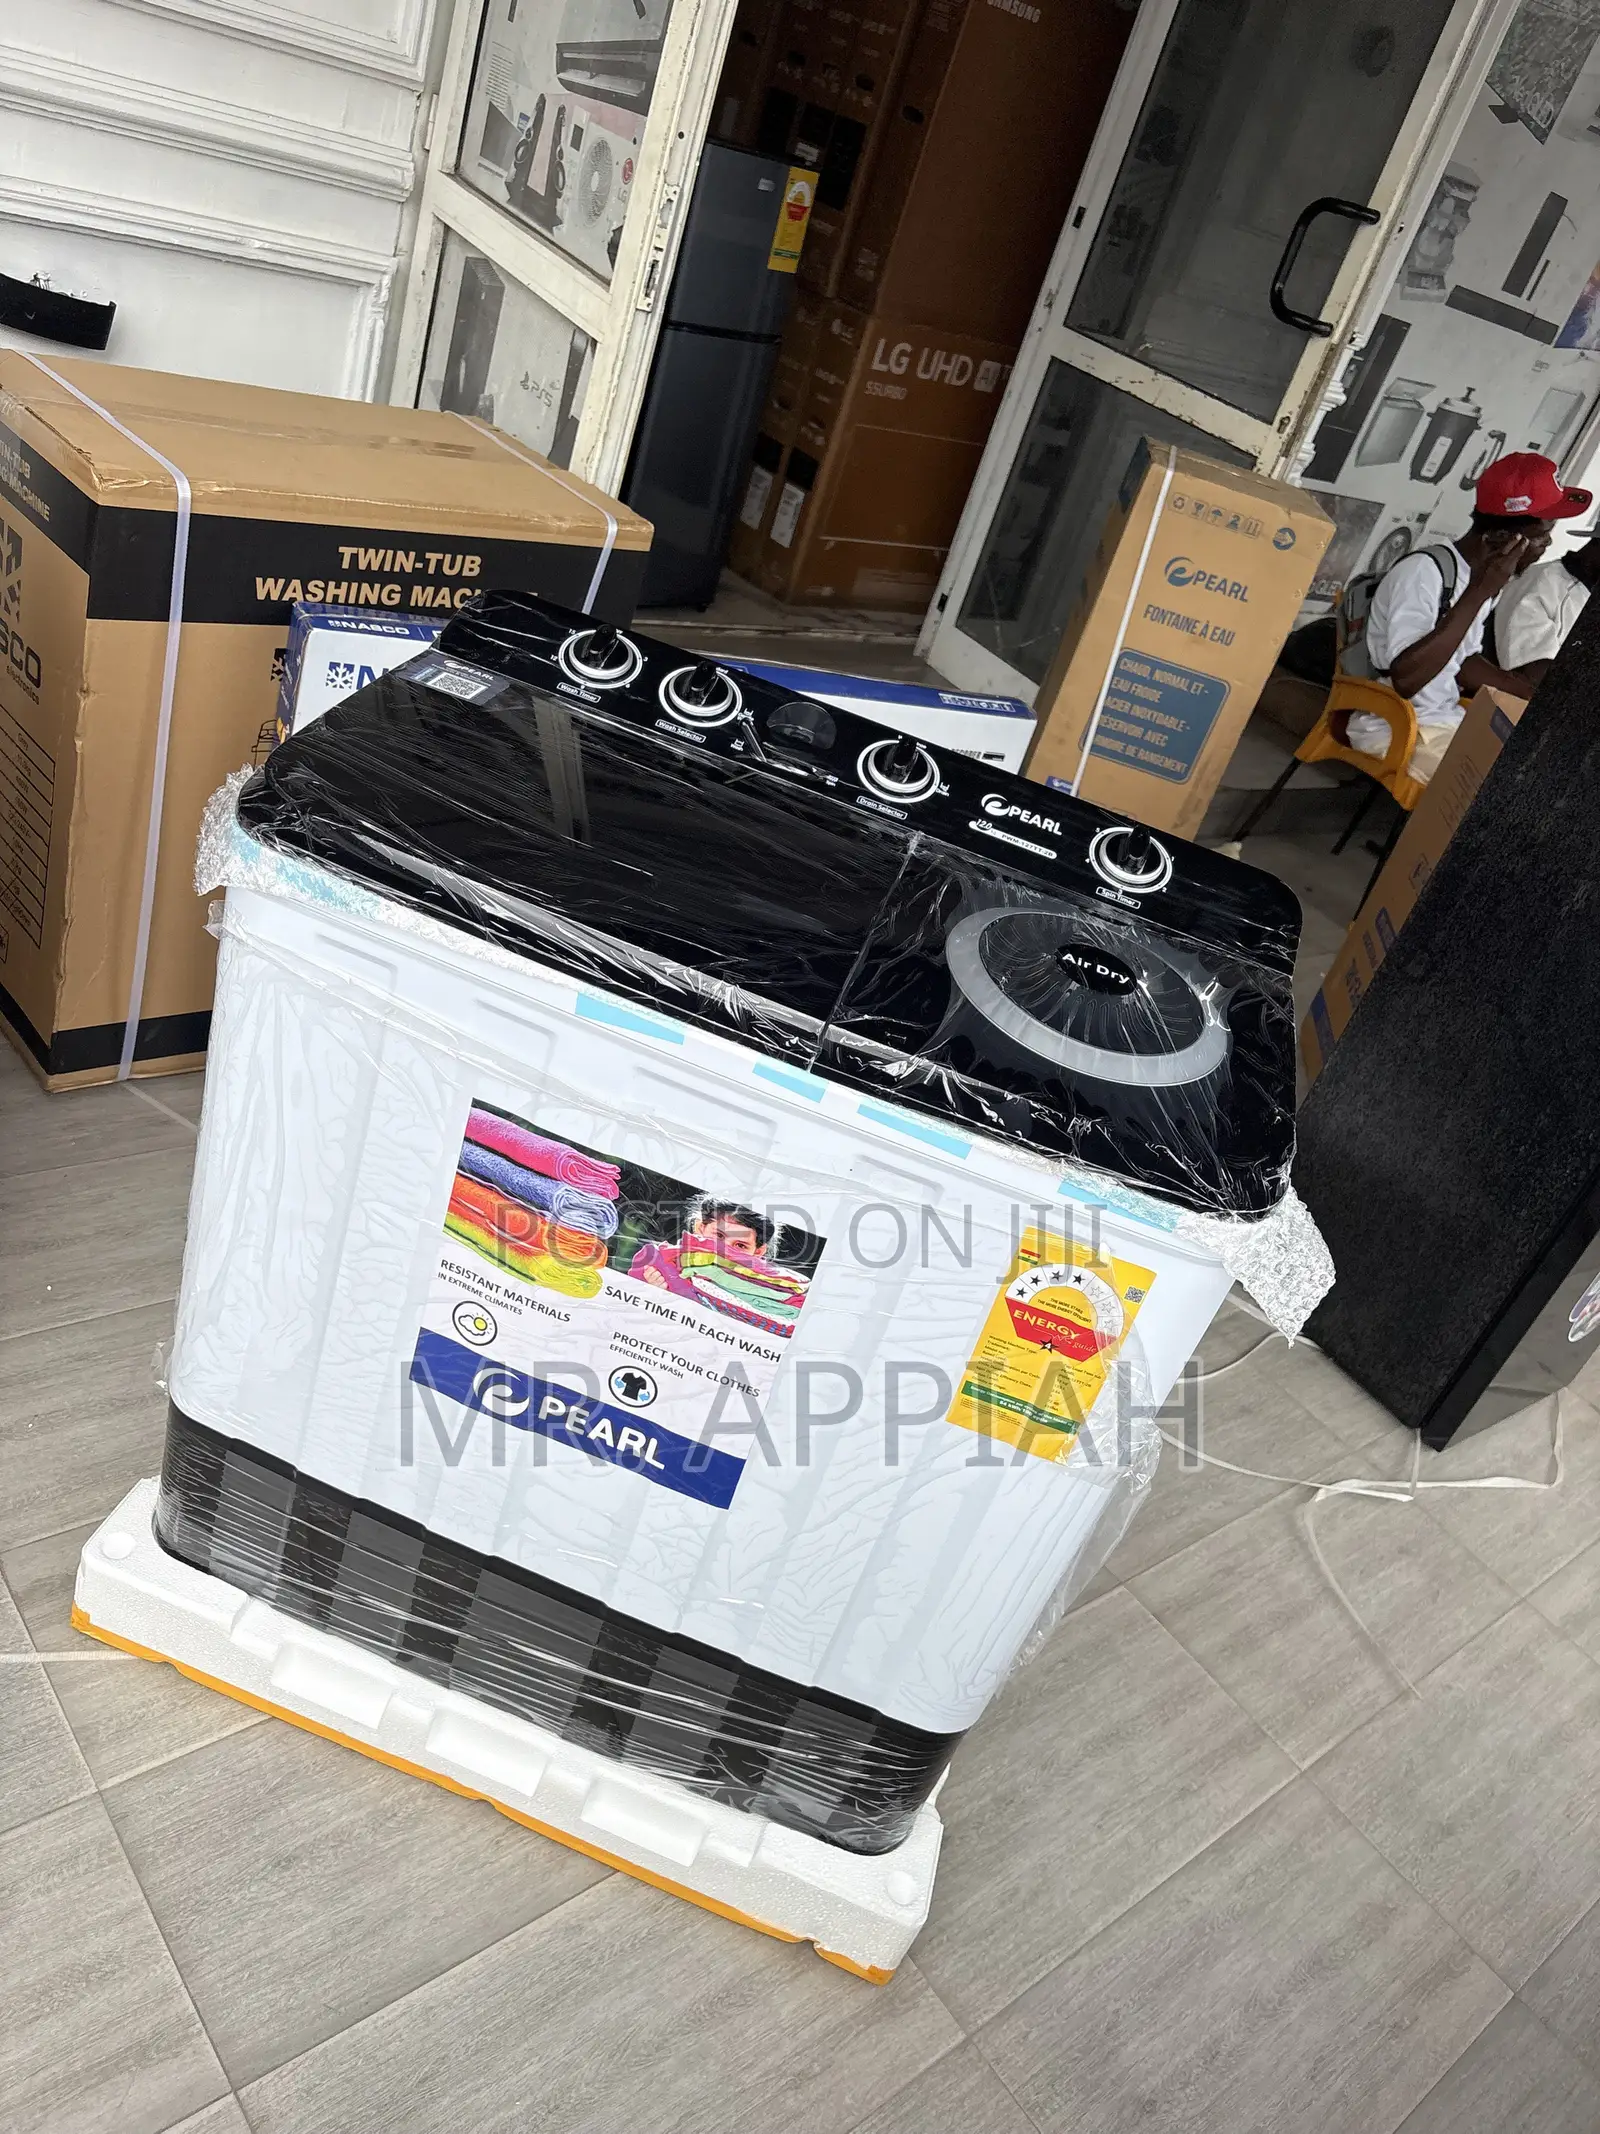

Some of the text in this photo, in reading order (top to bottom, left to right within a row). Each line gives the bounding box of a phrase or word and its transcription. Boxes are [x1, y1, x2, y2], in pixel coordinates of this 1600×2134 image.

[871, 337, 913, 375] LG
[916, 347, 974, 386] UHD
[338, 546, 482, 577] TWIN-TUB
[255, 577, 401, 606] WASHING
[1192, 570, 1249, 603] PEARL
[342, 620, 410, 635] NASCO
[1143, 604, 1236, 647] FONTAINE À EAU
[460, 666, 494, 680] PEARL
[1152, 669, 1190, 692] NORMAL
[1190, 681, 1204, 696] ET
[560, 683, 597, 701] Wash Timer
[659, 720, 703, 741] Wash Selector
[1143, 729, 1169, 748] AVEC
[860, 797, 904, 818] Drain Selector
[1008, 805, 1063, 836] PEARL
[1101, 888, 1135, 906] Spin Timer
[1062, 952, 1130, 984] Air Dry
[437, 1271, 523, 1315] IN EXTREME CLIMATES
[440, 1259, 572, 1322] RESISTANT MATERIALS
[604, 1285, 782, 1363] SAVE TIME IN EACH WASH
[1013, 1309, 1081, 1340] ENERGY
[609, 1344, 684, 1379] EFFICIENTLY WASH
[1071, 1342, 1097, 1352] guide
[613, 1331, 761, 1398] PROTECT YOUR CLOTHES
[538, 1395, 667, 1471] PEARL
